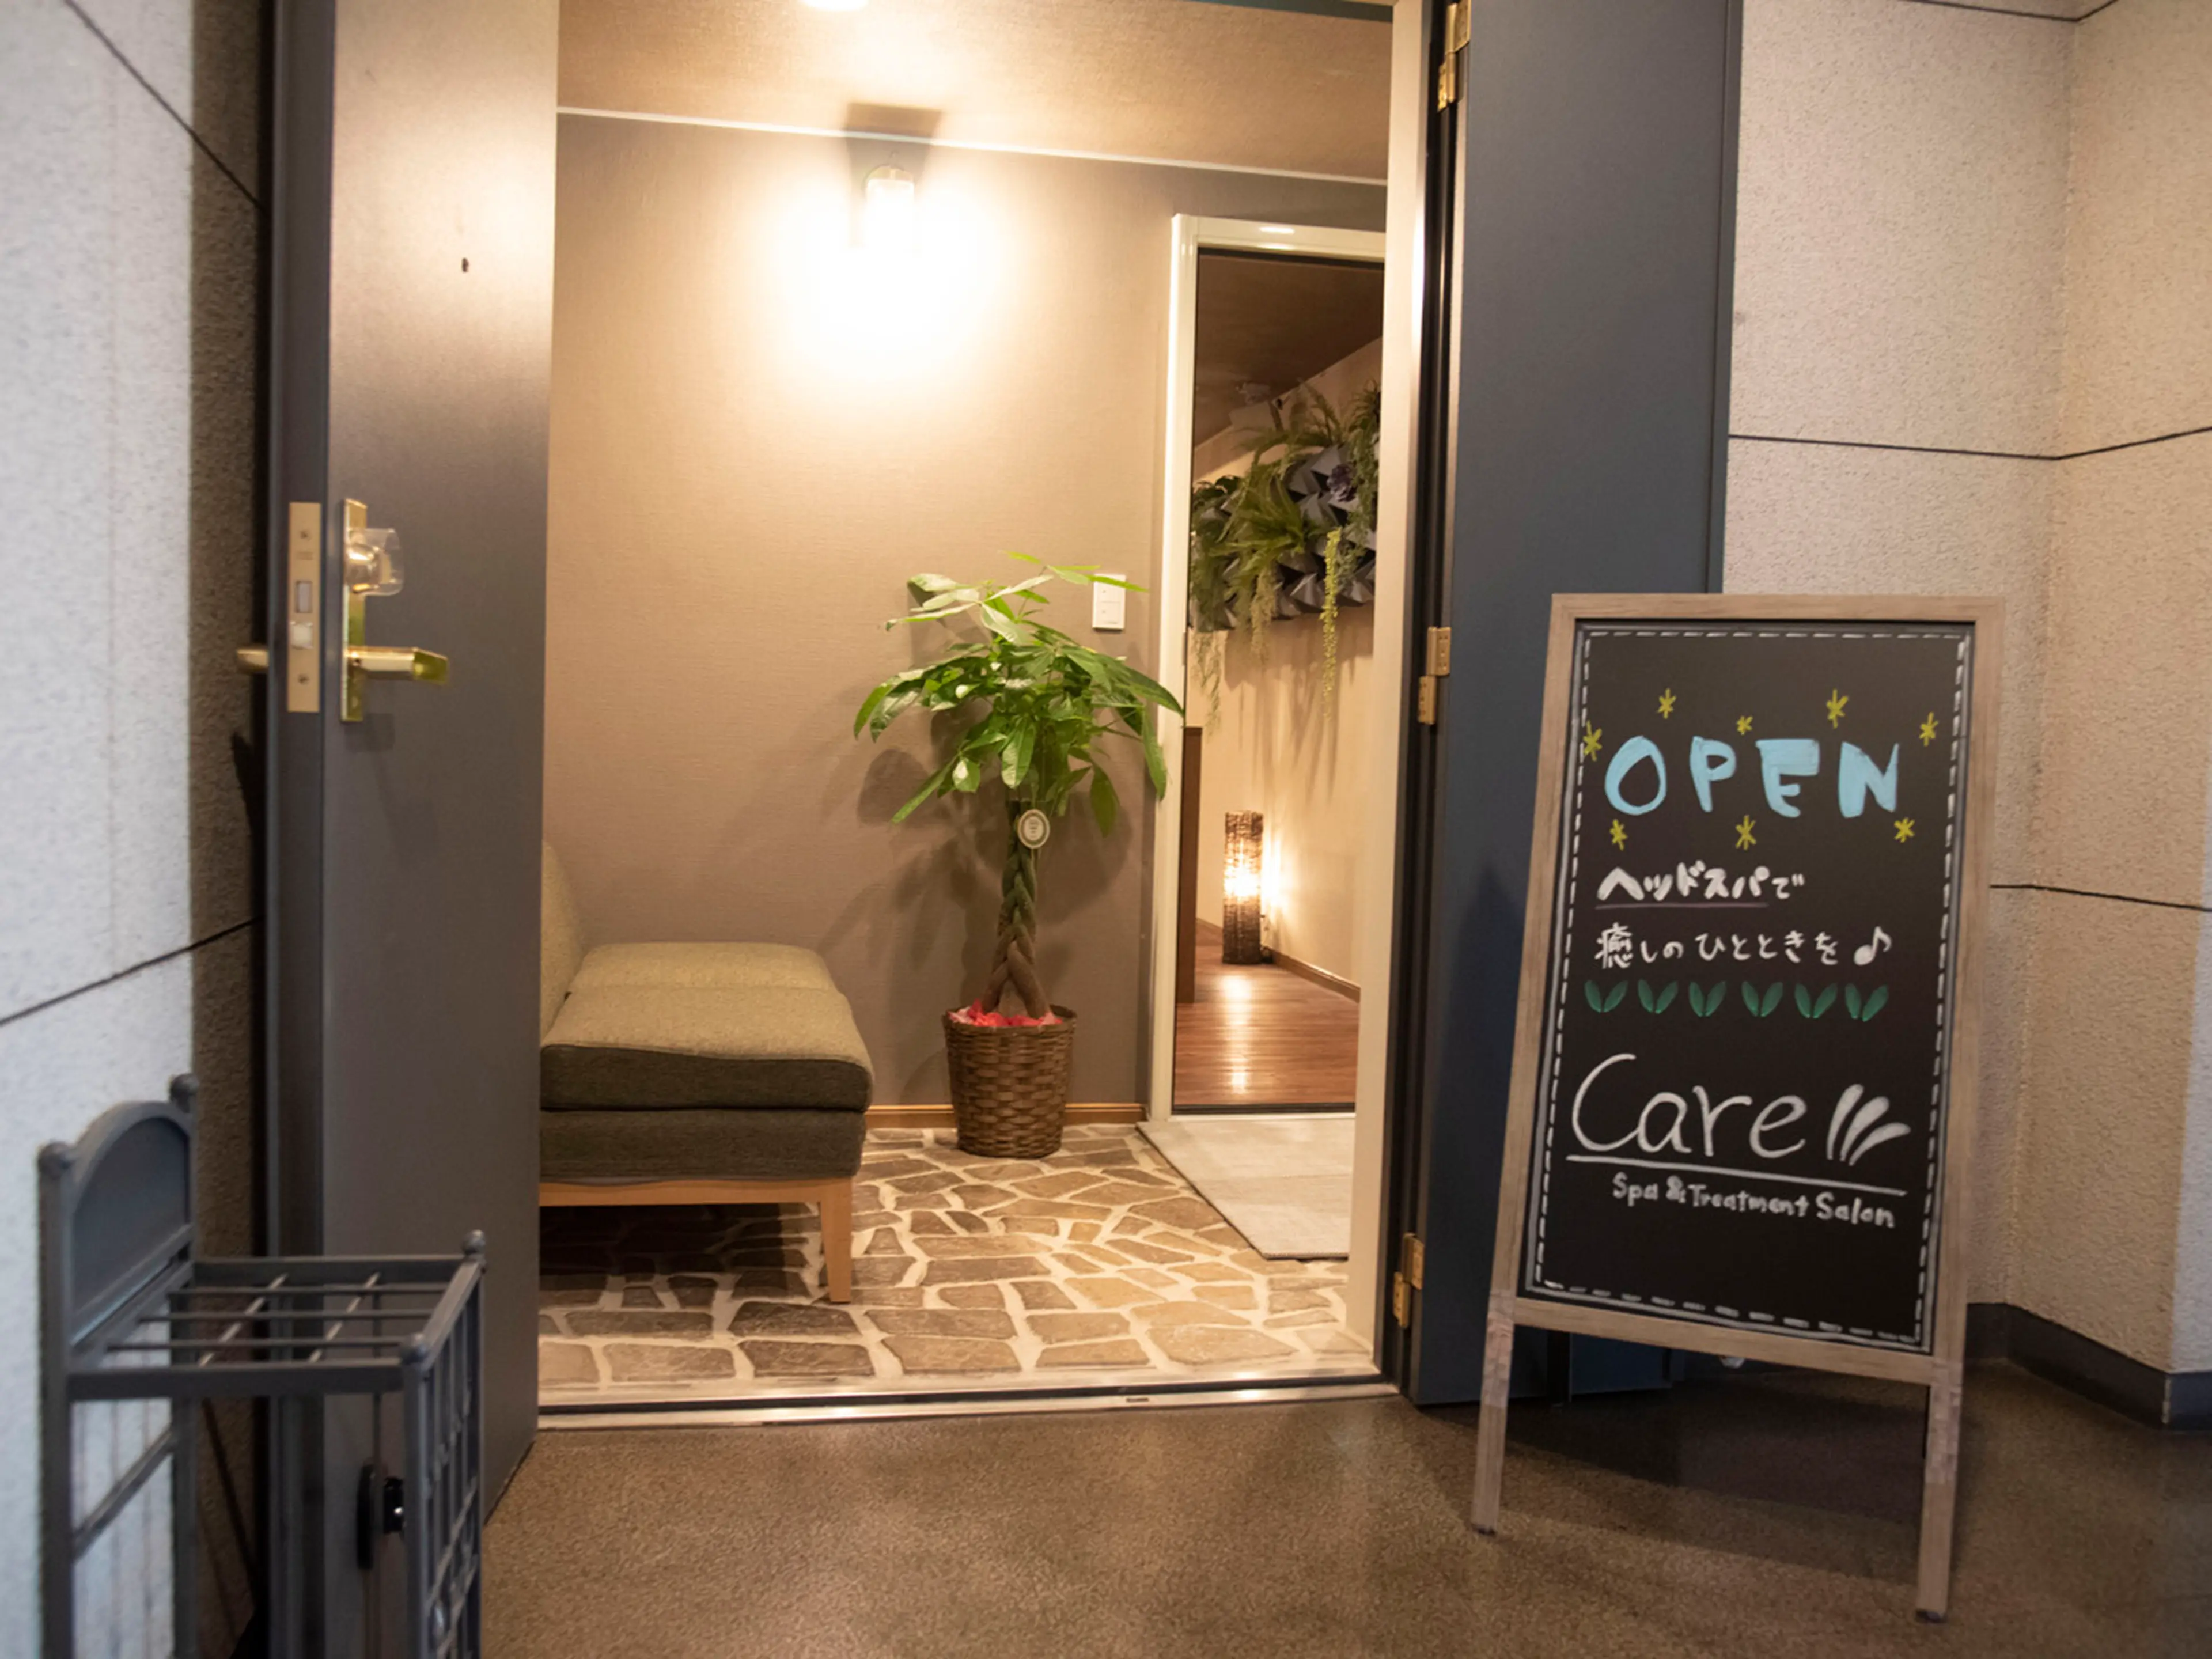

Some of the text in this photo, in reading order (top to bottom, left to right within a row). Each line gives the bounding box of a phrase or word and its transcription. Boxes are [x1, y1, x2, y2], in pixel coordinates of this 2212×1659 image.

[1604, 735, 1899, 819] OPEN
[1596, 859, 1805, 902] ヘッドスパで
[1571, 1053, 1808, 1159] Care
[1612, 1171, 1896, 1229] Spa & Treatment Salon
